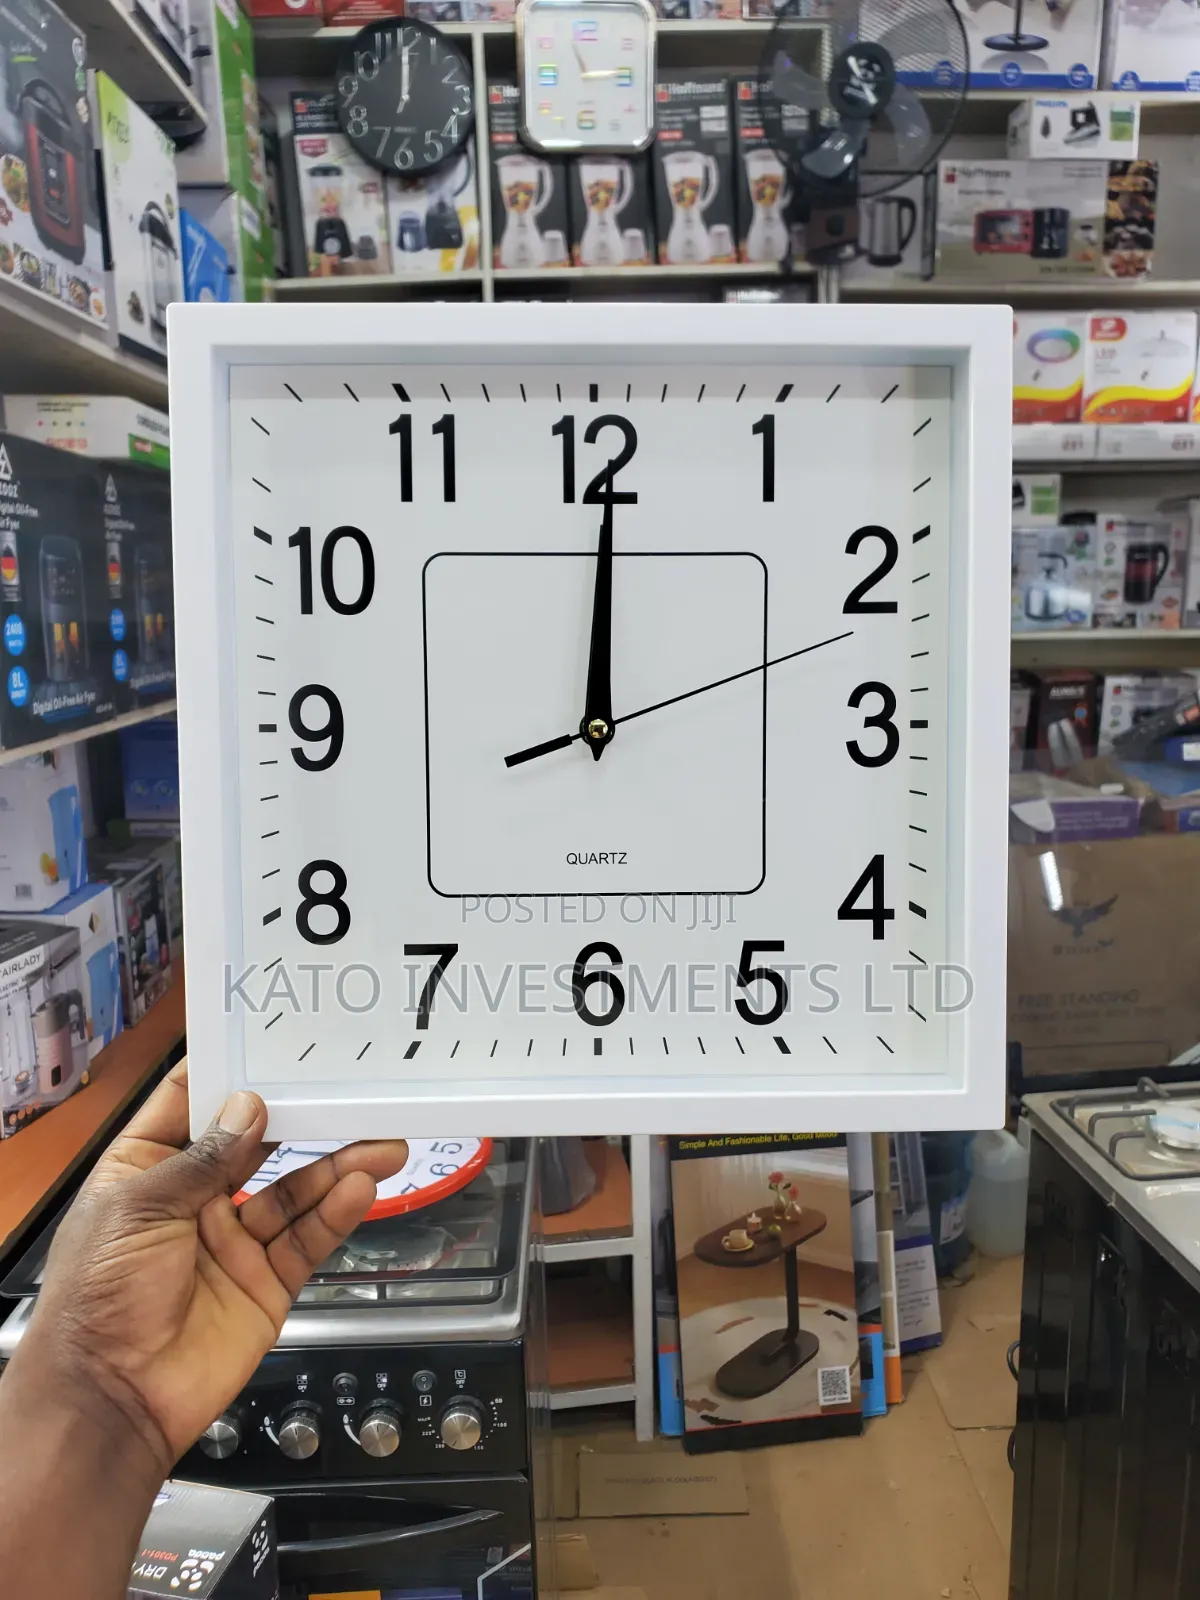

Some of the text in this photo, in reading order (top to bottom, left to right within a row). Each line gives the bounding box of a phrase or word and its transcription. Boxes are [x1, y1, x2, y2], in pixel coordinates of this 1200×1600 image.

[338, 74, 359, 108] 9
[354, 51, 380, 81] 10
[441, 55, 459, 84] 2
[347, 105, 369, 138] 8
[440, 114, 459, 144] 4
[452, 85, 471, 116] 3
[372, 126, 392, 158] 7
[394, 136, 414, 170] 6
[424, 130, 444, 163] 5
[389, 414, 456, 502] 11
[552, 414, 638, 504] 12
[752, 414, 775, 502] 1
[288, 525, 375, 615] 10
[842, 525, 899, 614] 2
[288, 683, 344, 772] 9
[845, 681, 900, 767] 3
[566, 852, 628, 866] QUARTZ
[295, 859, 351, 945] 8
[837, 854, 895, 940] 4
[403, 943, 459, 1030] 7
[571, 941, 625, 1026] 6
[734, 940, 789, 1025] 5
[679, 1139, 706, 1150] Simple
[708, 1138, 723, 1148] And
[725, 1135, 772, 1146] Fashionable
[133, 1563, 168, 1579] DRY
